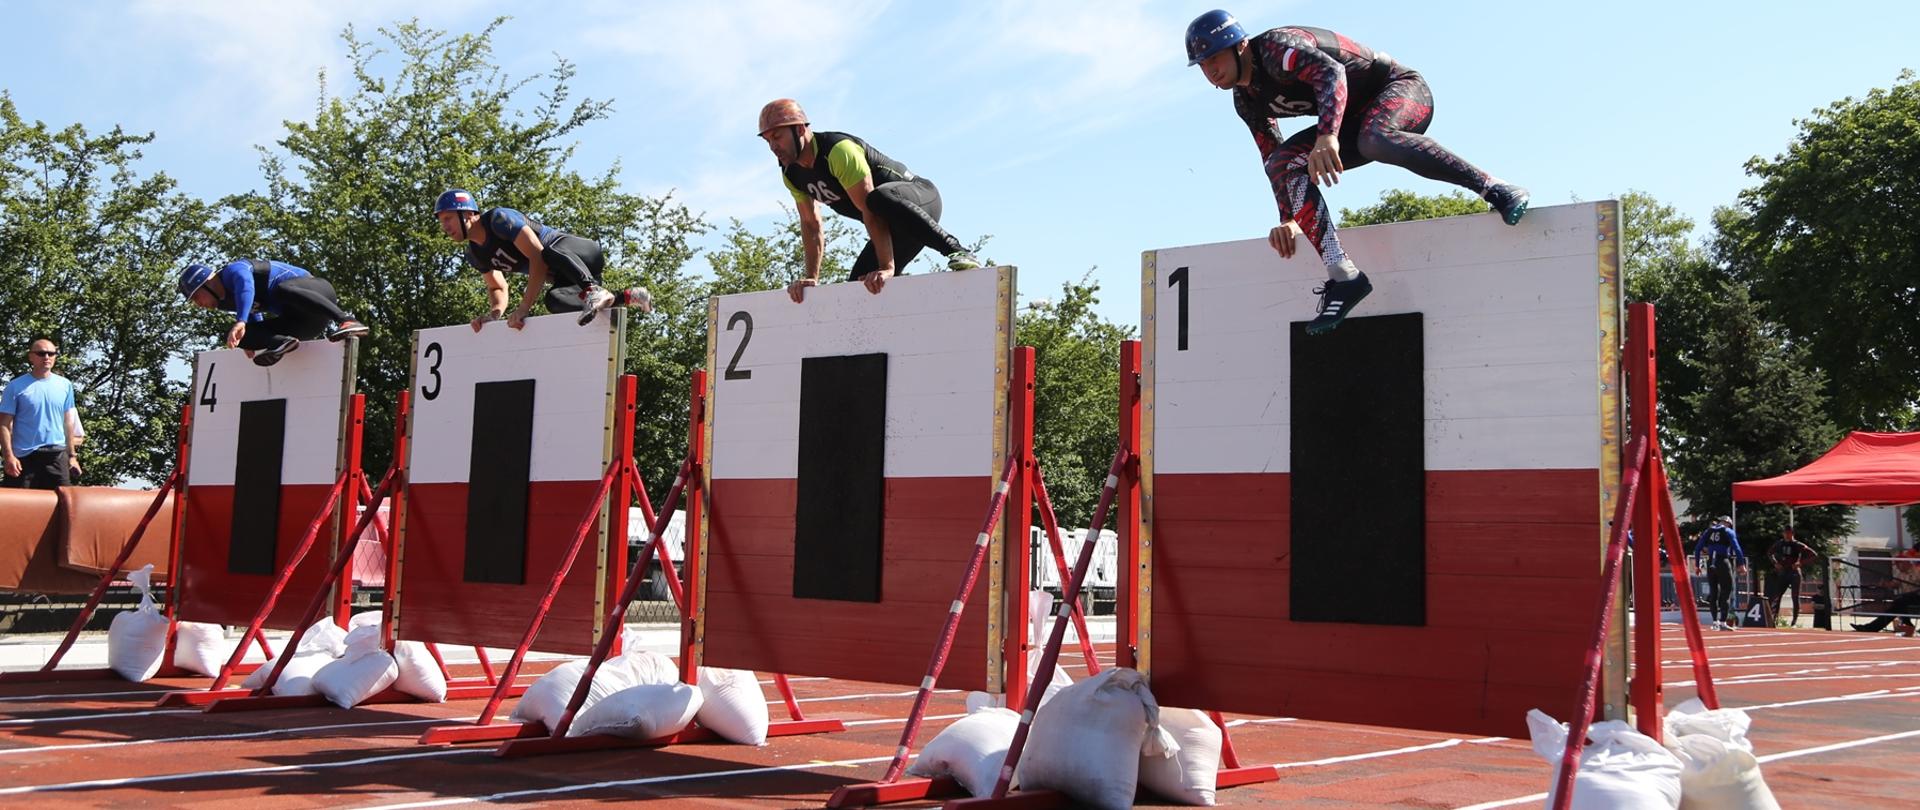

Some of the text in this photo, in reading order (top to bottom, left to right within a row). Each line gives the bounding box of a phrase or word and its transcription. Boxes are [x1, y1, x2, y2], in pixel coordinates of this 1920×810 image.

[1268, 94, 1313, 115] 15
[807, 180, 841, 204] 26
[491, 248, 518, 272] 37
[1168, 266, 1189, 352] 1
[725, 311, 754, 381] 2
[422, 342, 443, 401] 3
[200, 363, 218, 413] 4
[1710, 532, 1720, 542] 46
[1747, 603, 1761, 621] 4
